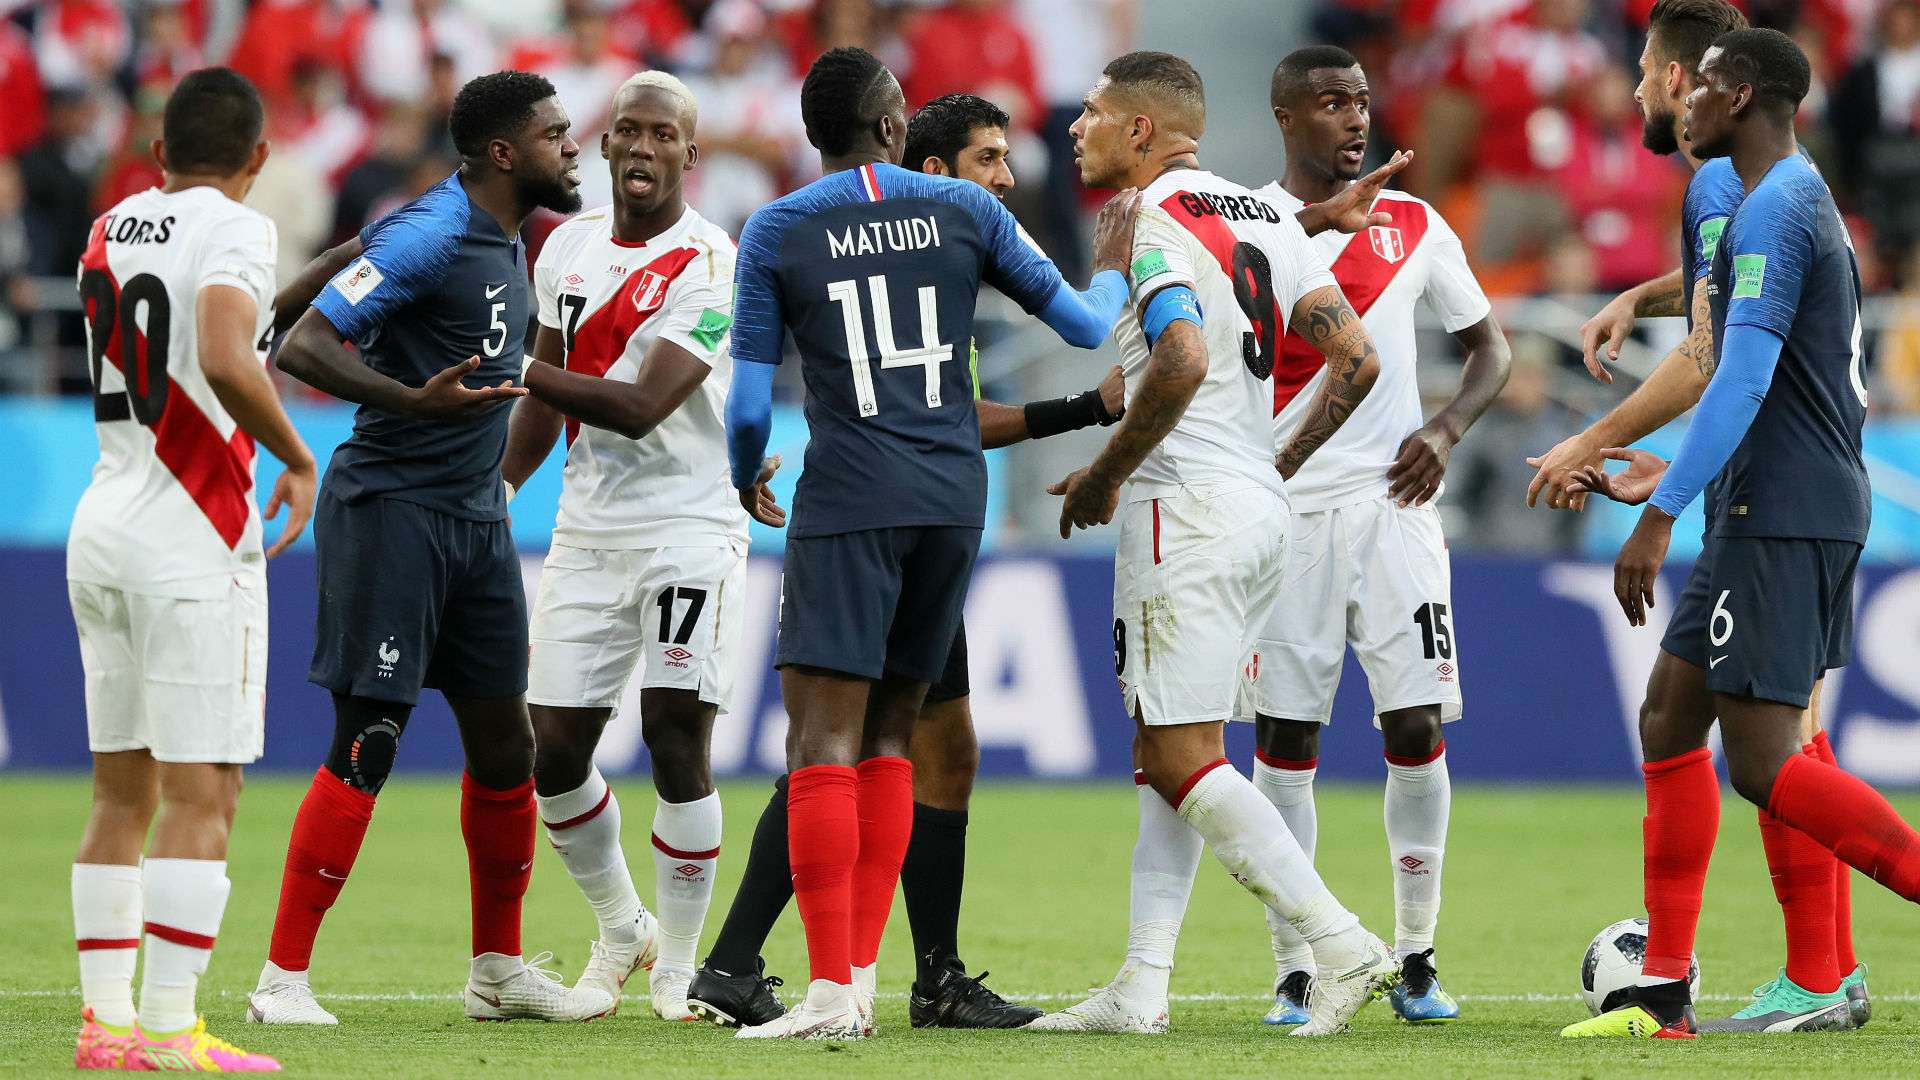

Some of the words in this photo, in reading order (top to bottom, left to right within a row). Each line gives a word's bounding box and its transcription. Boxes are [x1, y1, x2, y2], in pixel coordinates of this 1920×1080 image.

[826, 215, 941, 259] MATUIDI
[482, 302, 508, 358] 5
[1231, 241, 1276, 382] 9
[79, 268, 171, 426] 20
[827, 274, 954, 418] 14
[656, 585, 708, 645] 17
[1413, 602, 1452, 660] 15
[1709, 589, 1734, 647] 6
[664, 659, 689, 670] umbro
[1112, 617, 1127, 677] 9
